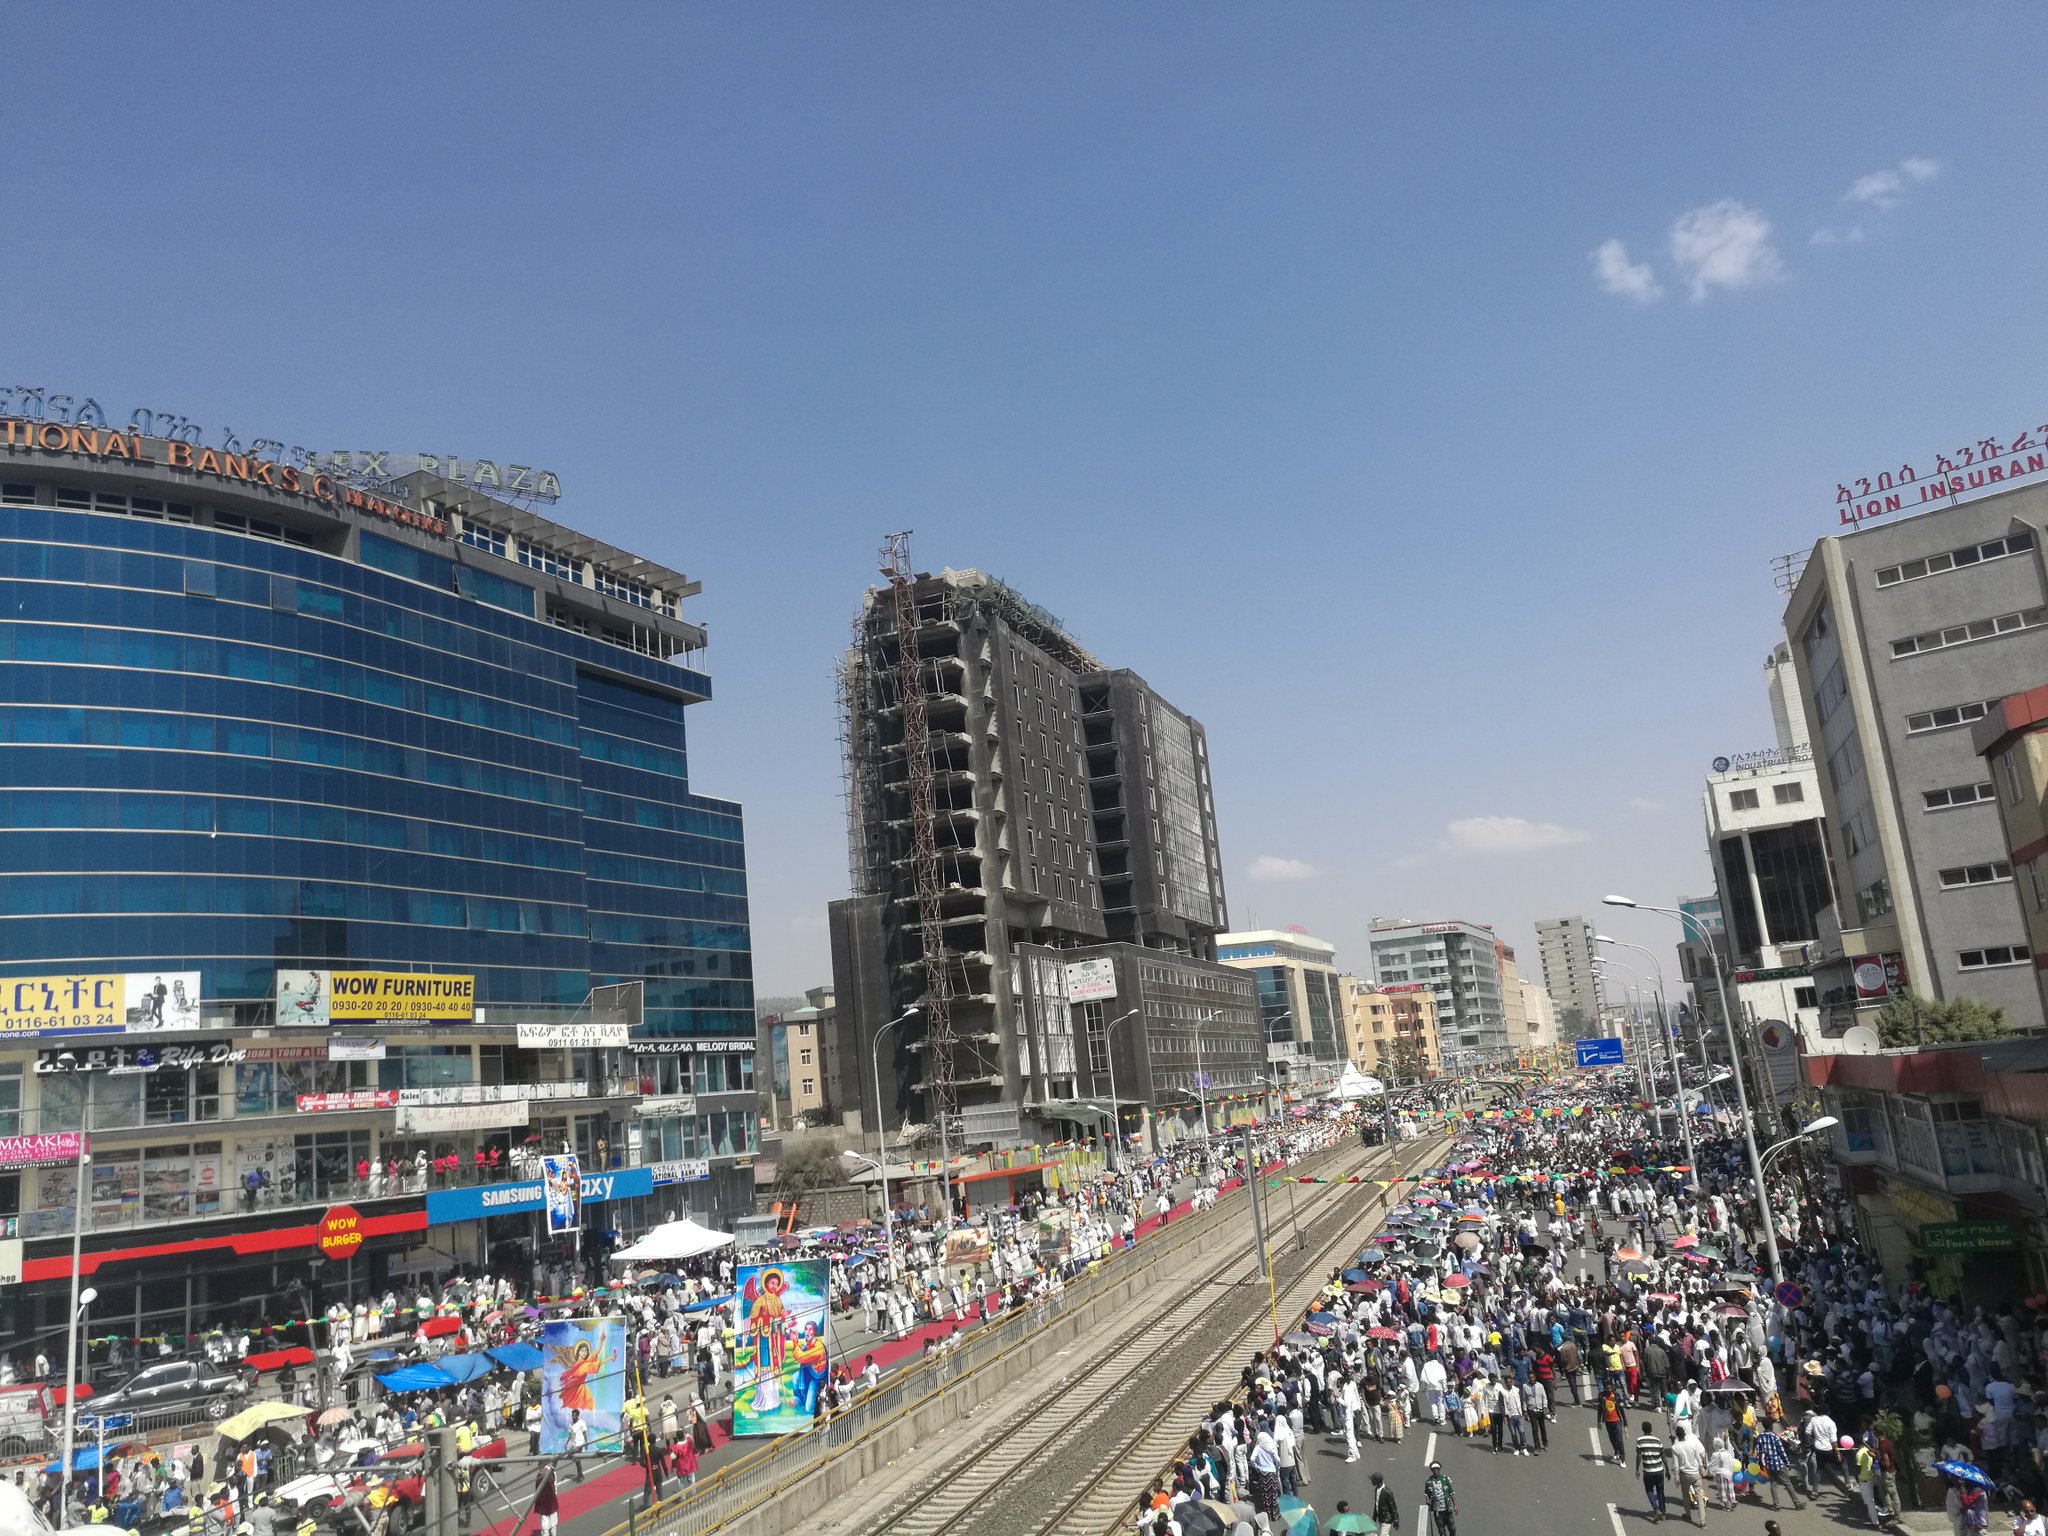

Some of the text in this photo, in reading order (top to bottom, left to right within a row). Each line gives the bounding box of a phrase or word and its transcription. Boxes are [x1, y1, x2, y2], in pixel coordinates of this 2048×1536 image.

[0, 418, 154, 460] TIONAL
[169, 440, 275, 485] BANK
[419, 452, 562, 499] PLAZA
[1840, 453, 2044, 525] LION INSURAN
[1735, 757, 1788, 772] INDUSTRIAL
[333, 977, 472, 997] WOW FURNITURE
[332, 1000, 373, 1011] 0930-20
[376, 1000, 388, 1011] 20
[391, 1001, 402, 1011] 20
[410, 1001, 446, 1012] 0930-40
[448, 1002, 459, 1012] 40
[461, 1002, 471, 1012] 40
[5, 1014, 114, 1029] 0116-61 03 24
[548, 1038, 567, 1047] 0911
[593, 1038, 602, 1046] 87
[696, 1042, 756, 1052] MELODY BRIDAL
[159, 1046, 206, 1071] Rifa
[400, 1092, 420, 1100] Sales
[0, 1134, 61, 1151] MARAKI
[35, 1145, 62, 1153] EVENT
[247, 1153, 261, 1162] DG
[681, 1169, 696, 1178] BANK
[482, 1184, 543, 1208] SAMSUNG
[327, 1217, 357, 1231] WOW
[322, 1232, 363, 1248] BURGER
[1945, 1237, 2012, 1249] Forex Bureau
